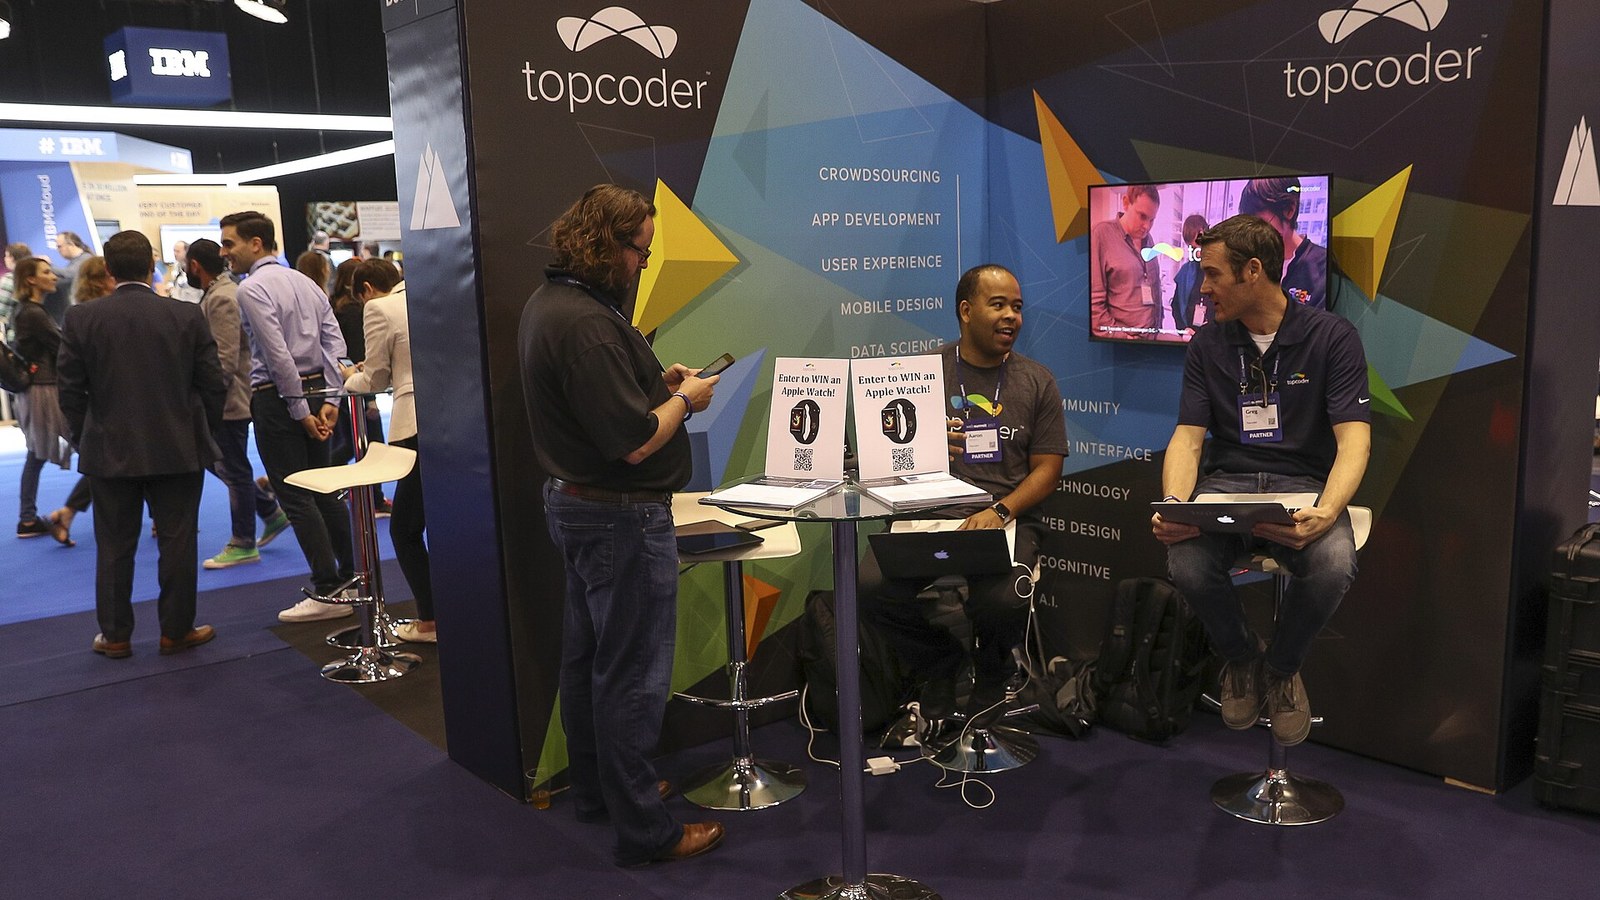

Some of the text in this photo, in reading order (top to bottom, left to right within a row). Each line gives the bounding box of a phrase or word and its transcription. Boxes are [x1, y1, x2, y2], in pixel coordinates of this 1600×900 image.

[148, 47, 211, 78] IBM
[1283, 41, 1482, 104] topcoder
[521, 61, 708, 113] topcoder
[59, 137, 103, 155] IBM
[819, 167, 940, 183] CROWDSOURCING
[812, 212, 942, 226] APP DEVELOPMENT
[821, 255, 942, 272] USER EXPERIENCE
[841, 297, 943, 316] MOBILE DESIGN
[851, 343, 885, 359] DATA
[778, 374, 800, 383] Enter
[801, 375, 810, 383] to
[811, 375, 829, 384] WIN
[858, 373, 936, 385] Enter to WIN an
[781, 386, 835, 397] Apple Watch!
[865, 384, 930, 399] Apple Watch!
[1075, 441, 1152, 462] INTERFACE
[1070, 521, 1121, 541] DESIGN
[1040, 554, 1111, 580] COGNITIVE
[1039, 593, 1058, 608] A.I.
